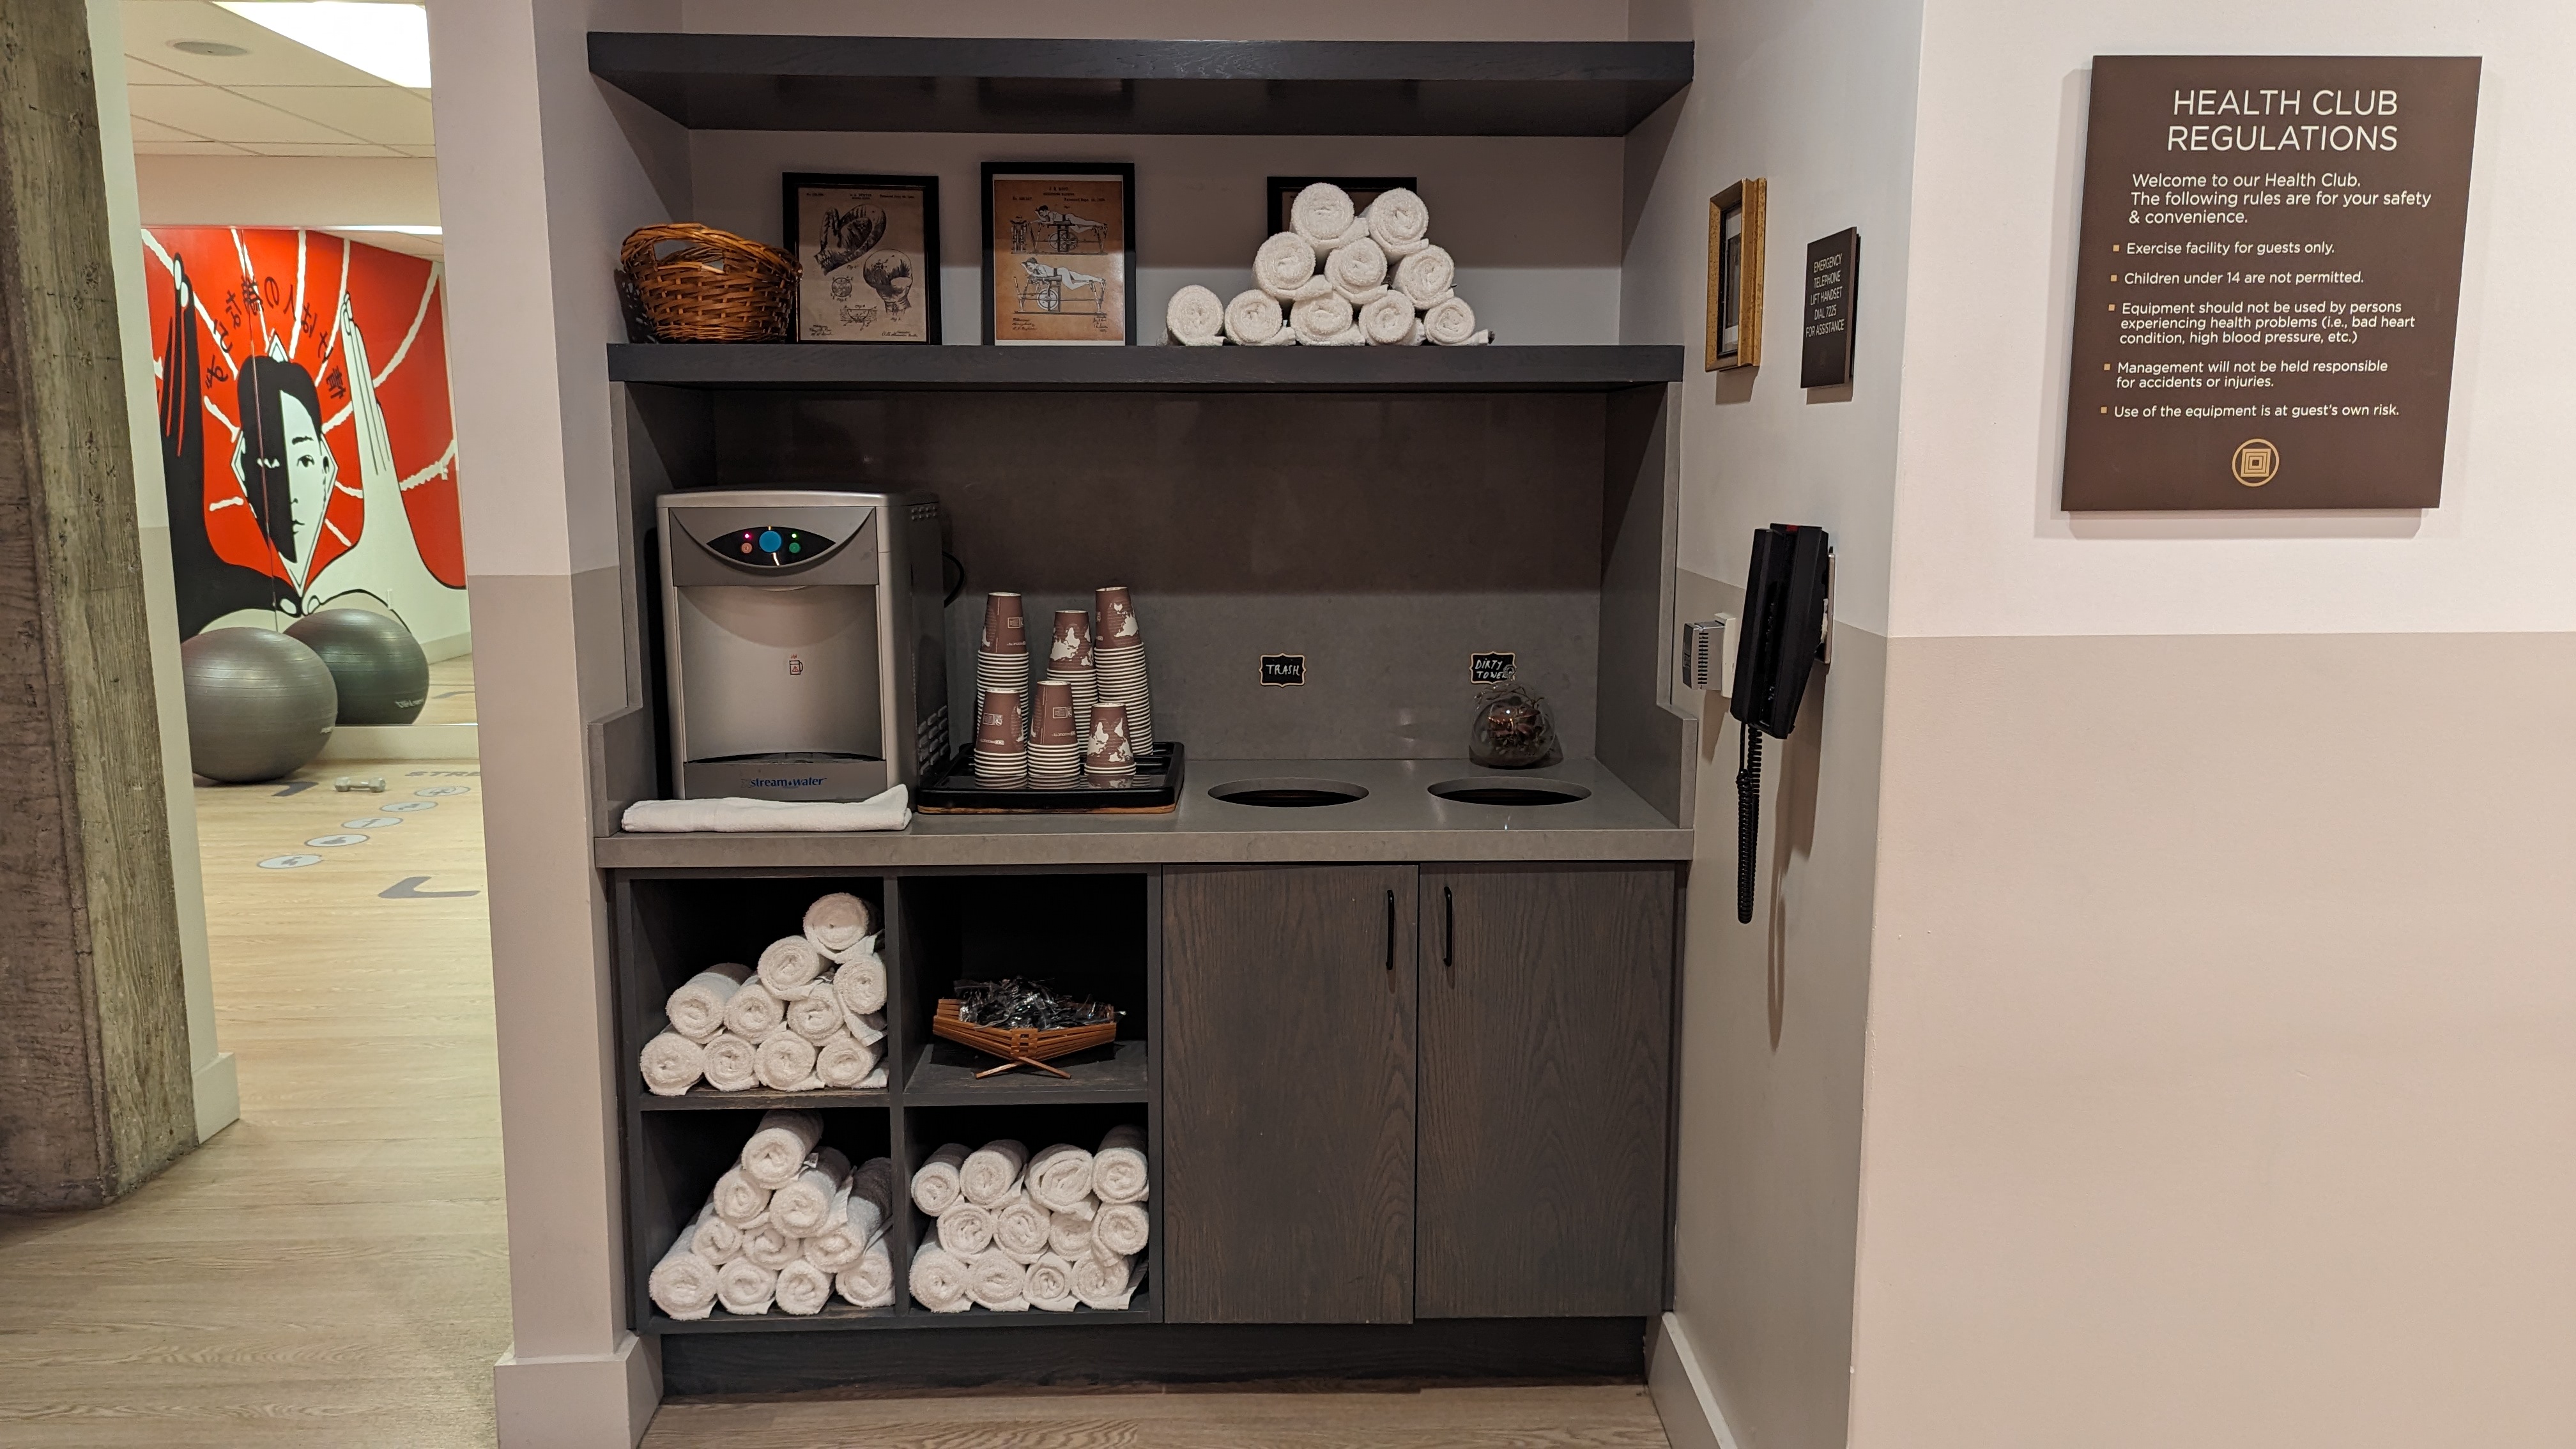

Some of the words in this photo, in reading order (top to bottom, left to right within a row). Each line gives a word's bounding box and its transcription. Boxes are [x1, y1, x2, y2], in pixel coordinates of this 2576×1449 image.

[2174, 89, 2301, 116] HEALTH
[2313, 89, 2398, 116] CLUB
[2168, 125, 2398, 151] REGULATIONS
[2132, 172, 2207, 188] Welcome
[2212, 173, 2228, 187] to
[2233, 176, 2260, 187] our
[2265, 172, 2316, 187] Health
[2321, 172, 2361, 187] Club.
[2131, 191, 2160, 206] The
[2165, 190, 2238, 208] following
[2243, 190, 2281, 205] rules
[2285, 194, 2311, 205] are
[2315, 190, 2339, 205] for
[2342, 194, 2379, 208] your
[2383, 190, 2432, 208] safety
[2129, 210, 2140, 224] &
[2145, 209, 2248, 224] convenience.
[2127, 241, 2182, 254] Exercise
[2186, 241, 2230, 256] facility
[2234, 241, 2254, 254] for
[2257, 241, 2301, 256] guests
[2304, 240, 2334, 256] only.
[1814, 254, 1843, 273] EMERGENCY
[1814, 270, 1841, 289] TELEPHONE
[2124, 272, 2180, 284] Children
[2184, 271, 2223, 284] under
[2227, 272, 2241, 284] 14
[2244, 273, 2266, 284] are
[2269, 272, 2292, 284] not
[2295, 270, 2364, 286] permitted.
[1810, 293, 1820, 305] LIFT
[1820, 286, 1843, 303] HANDSET
[1814, 308, 1825, 321] DIAL
[1826, 303, 1837, 318] 7225
[2122, 302, 2195, 316] Equipment
[2198, 301, 2244, 314] should
[2247, 302, 2270, 314] not
[2273, 300, 2290, 313] be
[2294, 300, 2326, 313] used
[2329, 300, 2347, 315] by
[2350, 303, 2402, 315] persons
[1805, 326, 1816, 337] FOR
[1816, 319, 1844, 335] ASSISTANCE
[2120, 316, 2206, 332] experiencing
[2210, 316, 2251, 328] health
[2255, 315, 2317, 330] problems
[2321, 316, 2347, 330] (i.e.,
[2352, 315, 2377, 328] bad
[2380, 315, 2416, 328] heart
[2119, 332, 2185, 345] condition,
[2189, 331, 2218, 346] high
[2222, 330, 2261, 343] blood
[2264, 333, 2324, 345] pressure,
[2327, 330, 2358, 344] etc.)
[2117, 362, 2204, 376] Management
[2207, 360, 2230, 373] will
[2234, 361, 2257, 372] not
[2260, 360, 2277, 372] be
[2280, 360, 2309, 372] held
[2313, 359, 2388, 374] responsible
[2116, 376, 2136, 388] for
[2138, 376, 2202, 388] accidents
[2206, 378, 2221, 388] or
[2224, 375, 2274, 390] injuries.
[2114, 406, 2139, 418] Use
[2142, 405, 2158, 417] of
[2160, 405, 2182, 417] the
[2185, 404, 2257, 419] equipment
[2260, 404, 2271, 417] is
[2274, 404, 2288, 417] at
[2292, 404, 2338, 418] guest's
[2342, 406, 2370, 416] own
[2373, 403, 2399, 416] risk.
[1265, 664, 1300, 676] TRASH
